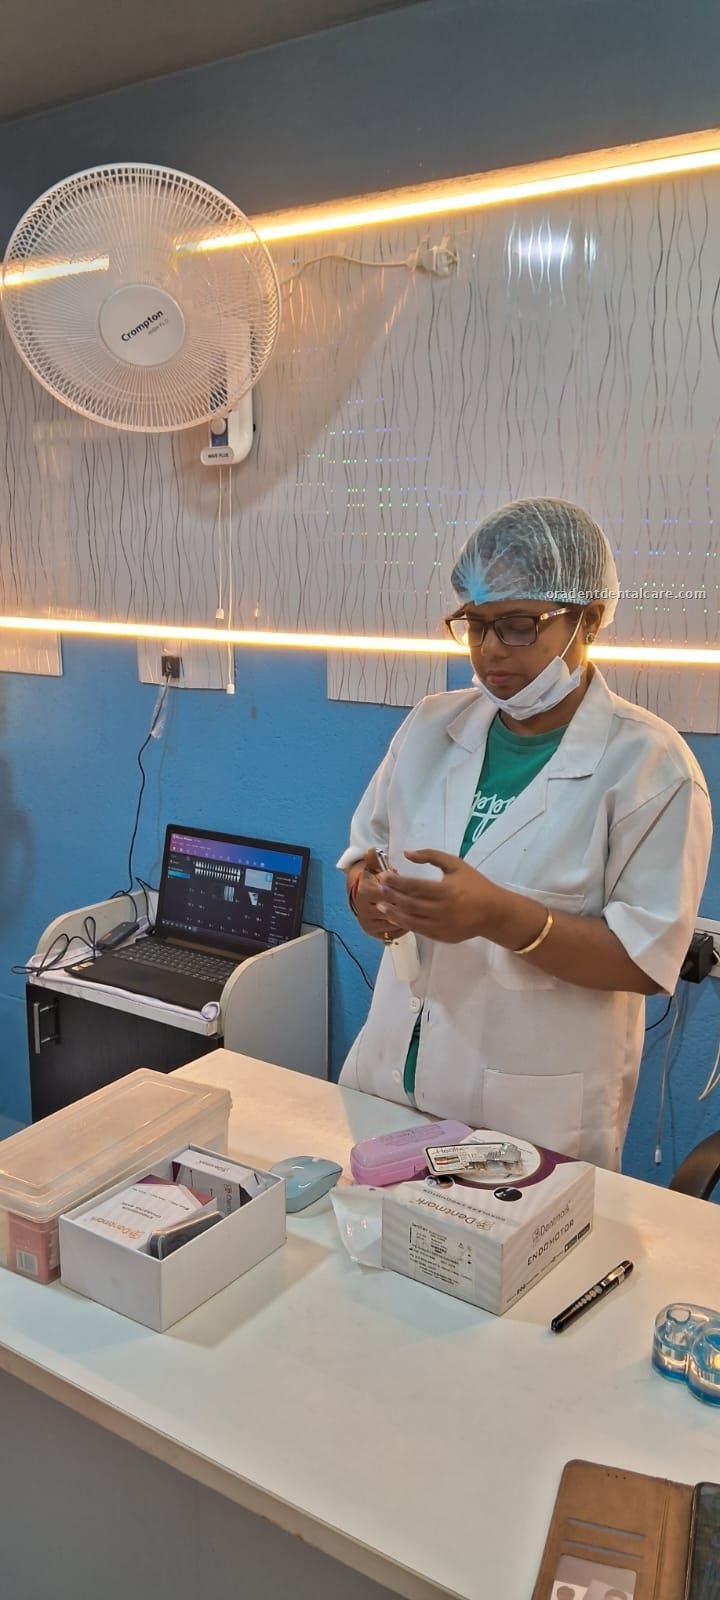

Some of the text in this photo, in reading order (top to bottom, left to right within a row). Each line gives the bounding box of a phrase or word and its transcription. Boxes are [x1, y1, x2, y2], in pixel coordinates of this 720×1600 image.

[121, 311, 164, 342] Crompton
[416, 1197, 477, 1225] Dentmark
[527, 1219, 575, 1267] ENDOMOTOR
